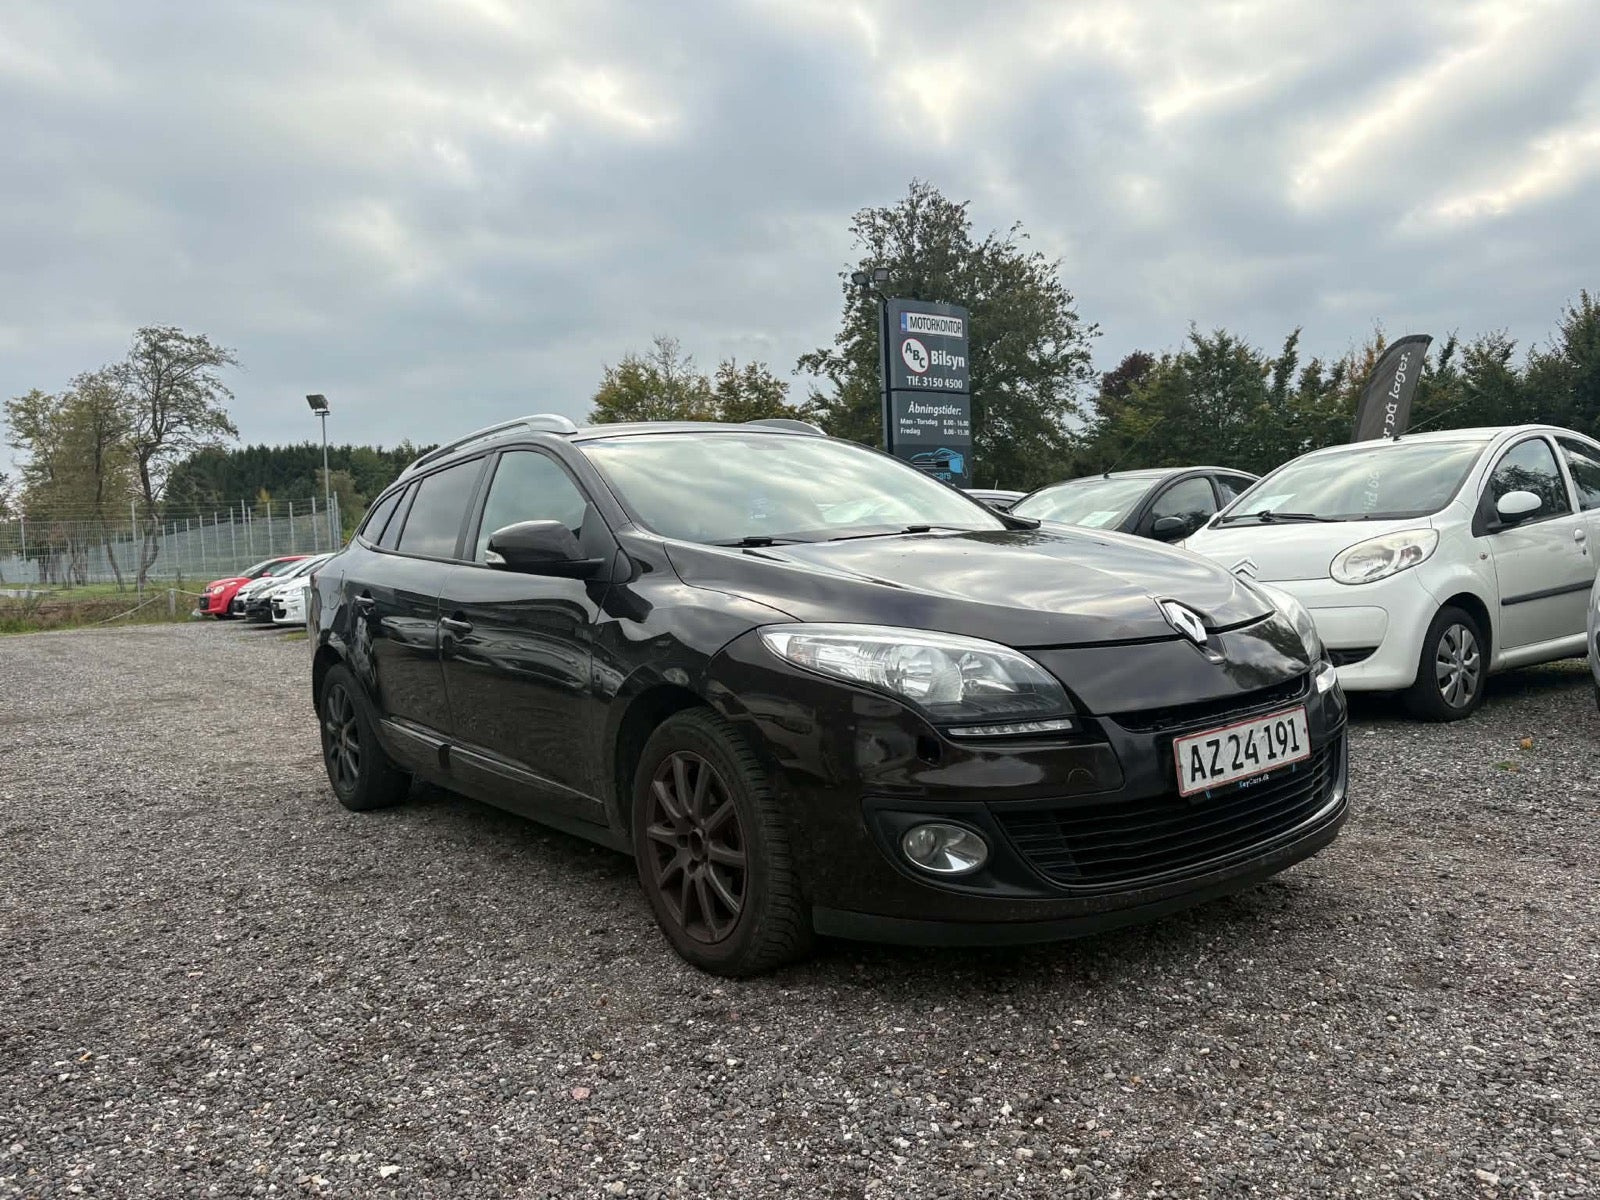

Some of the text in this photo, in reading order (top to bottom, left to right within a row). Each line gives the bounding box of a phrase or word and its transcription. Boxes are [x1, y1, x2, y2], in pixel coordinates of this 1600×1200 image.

[909, 316, 963, 334] MOTORKONTOR
[931, 350, 965, 370] Bilsyn
[906, 375, 963, 389] Tlf. 3150 4500
[1388, 352, 1411, 399] lager.
[908, 401, 962, 416] Åbningstider:
[917, 418, 938, 427] Torsdag
[900, 427, 921, 436] Fredag
[1191, 718, 1300, 782] AZ 24 191
